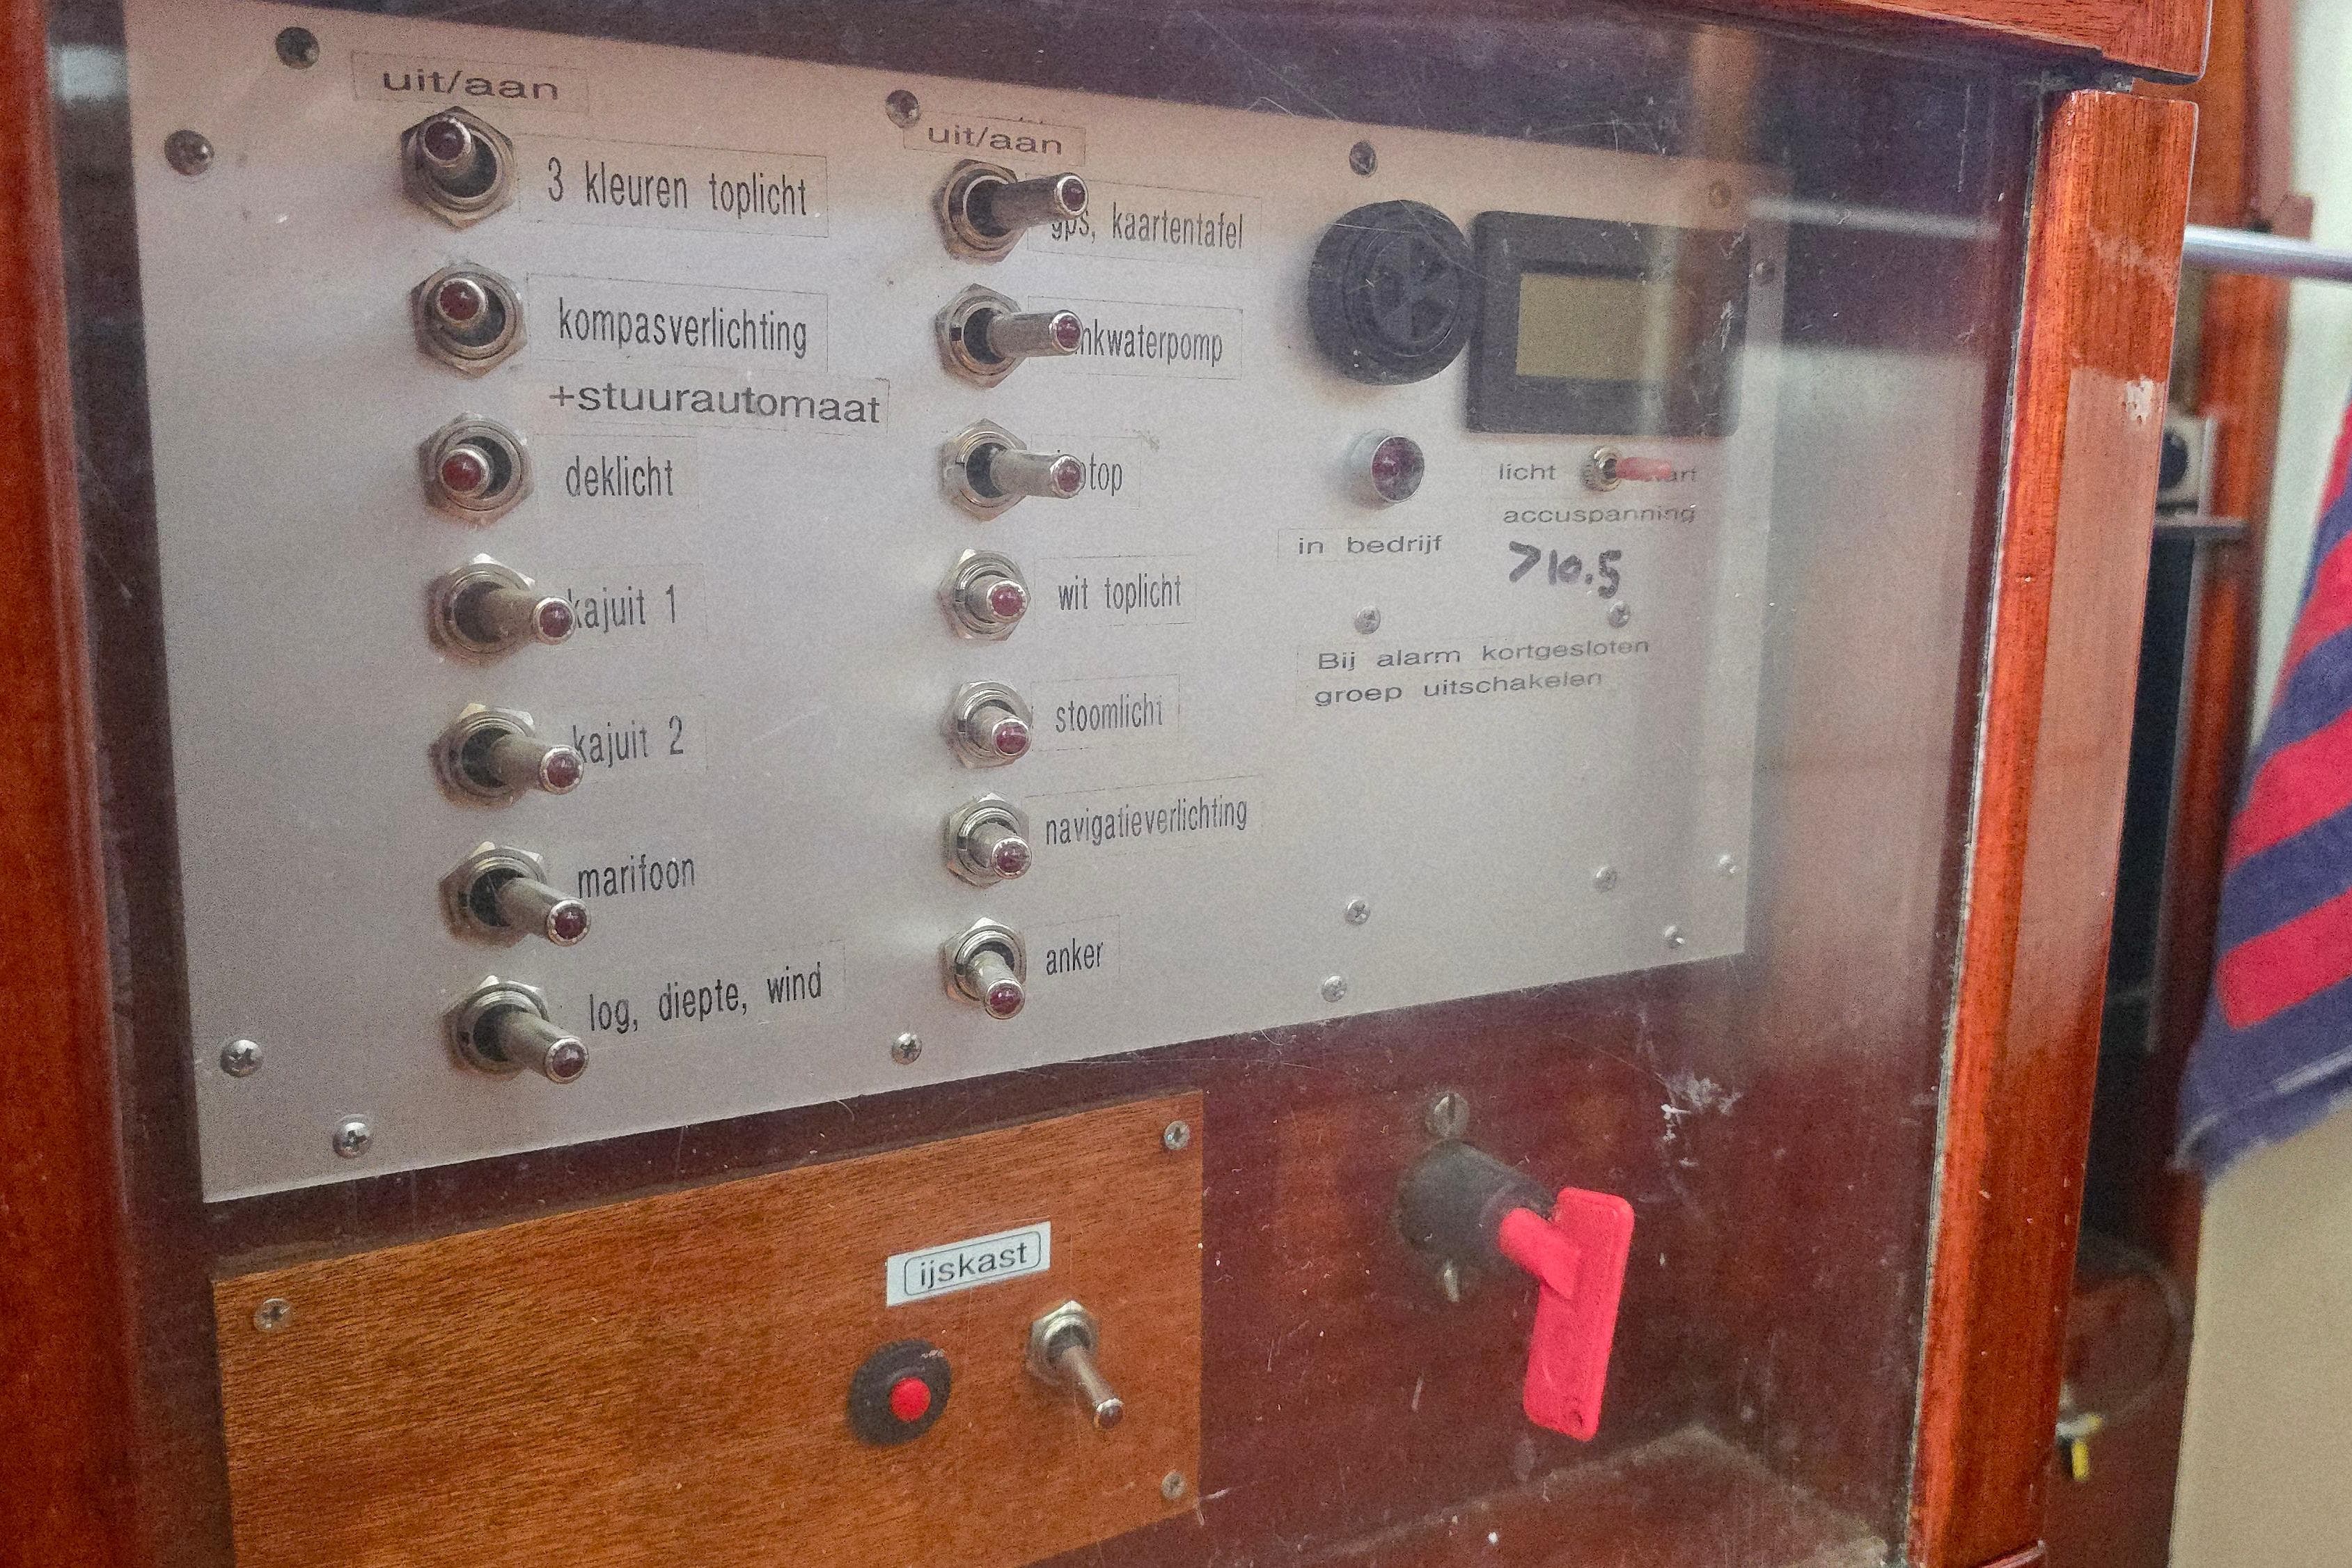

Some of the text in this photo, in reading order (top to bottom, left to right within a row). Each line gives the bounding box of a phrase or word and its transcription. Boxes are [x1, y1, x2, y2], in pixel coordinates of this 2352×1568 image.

[383, 69, 558, 100] uit/aan
[928, 125, 1062, 155] uit/aan
[548, 157, 807, 219] 3 kleuren toplicht
[1113, 201, 1244, 249] kaartentafel
[558, 297, 808, 359] kompasverlichting
[1075, 318, 1223, 367] nkwaterpomp
[549, 382, 881, 423] +stuurautomaat
[565, 455, 674, 497] deklicht
[1498, 462, 1556, 481] licht
[1503, 506, 1696, 524] accuspanning
[1298, 534, 1443, 555] in bedrijf
[567, 584, 675, 634] kajuit 1
[1058, 573, 1182, 613] wit toplicht
[1318, 638, 1649, 671] Bij alarm kortgesloten
[1315, 671, 1602, 707] groep uitschakelen
[1056, 693, 1163, 732] stoomlicht
[573, 715, 684, 768] kajuit 2
[1045, 794, 1248, 847] navigatieverlichting
[578, 854, 695, 899] marifoon
[1045, 938, 1104, 975] anker
[590, 962, 822, 1034] log, diepte, wind
[920, 1241, 1028, 1289] ijskast
